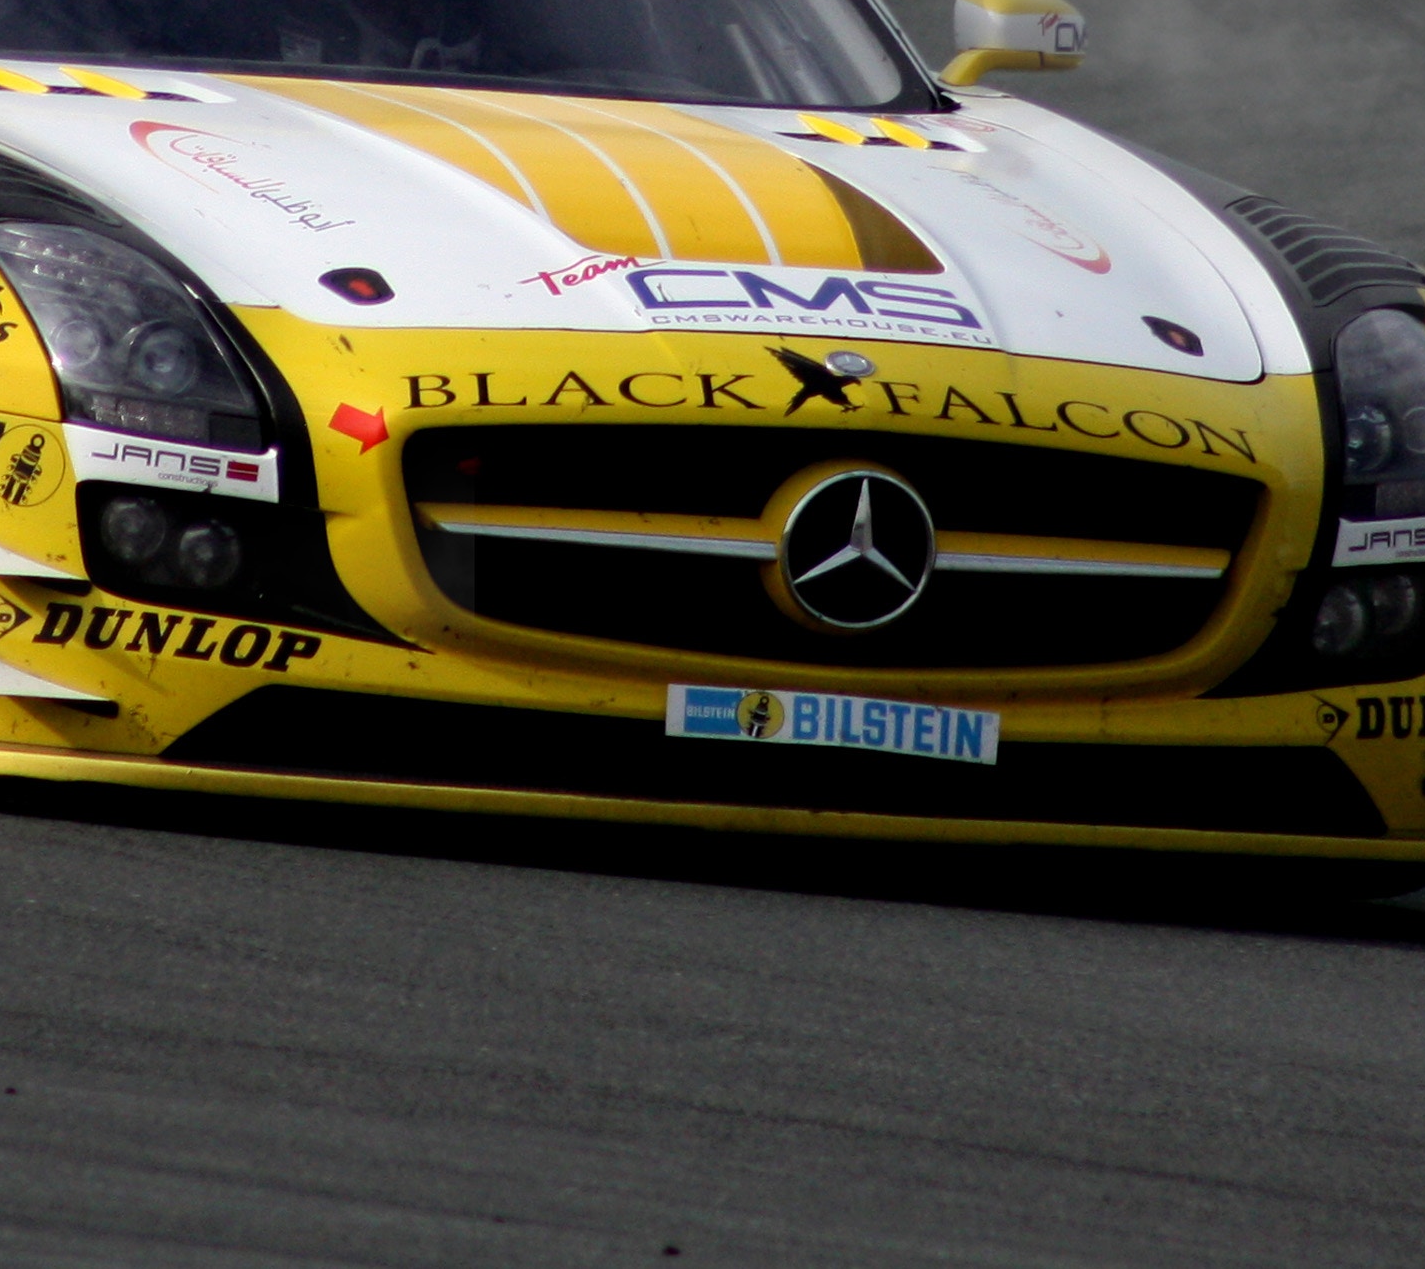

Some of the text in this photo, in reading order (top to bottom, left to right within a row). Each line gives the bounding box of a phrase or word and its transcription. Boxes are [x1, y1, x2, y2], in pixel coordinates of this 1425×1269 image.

[517, 254, 667, 296] Team
[625, 269, 982, 330] CMS
[651, 314, 993, 346] CMSWAREHOUSE.EU
[401, 370, 1257, 464] BLACK FALCON
[32, 602, 322, 672] DUNLOP
[686, 694, 984, 759] BILSTEIN BILSTEIN
